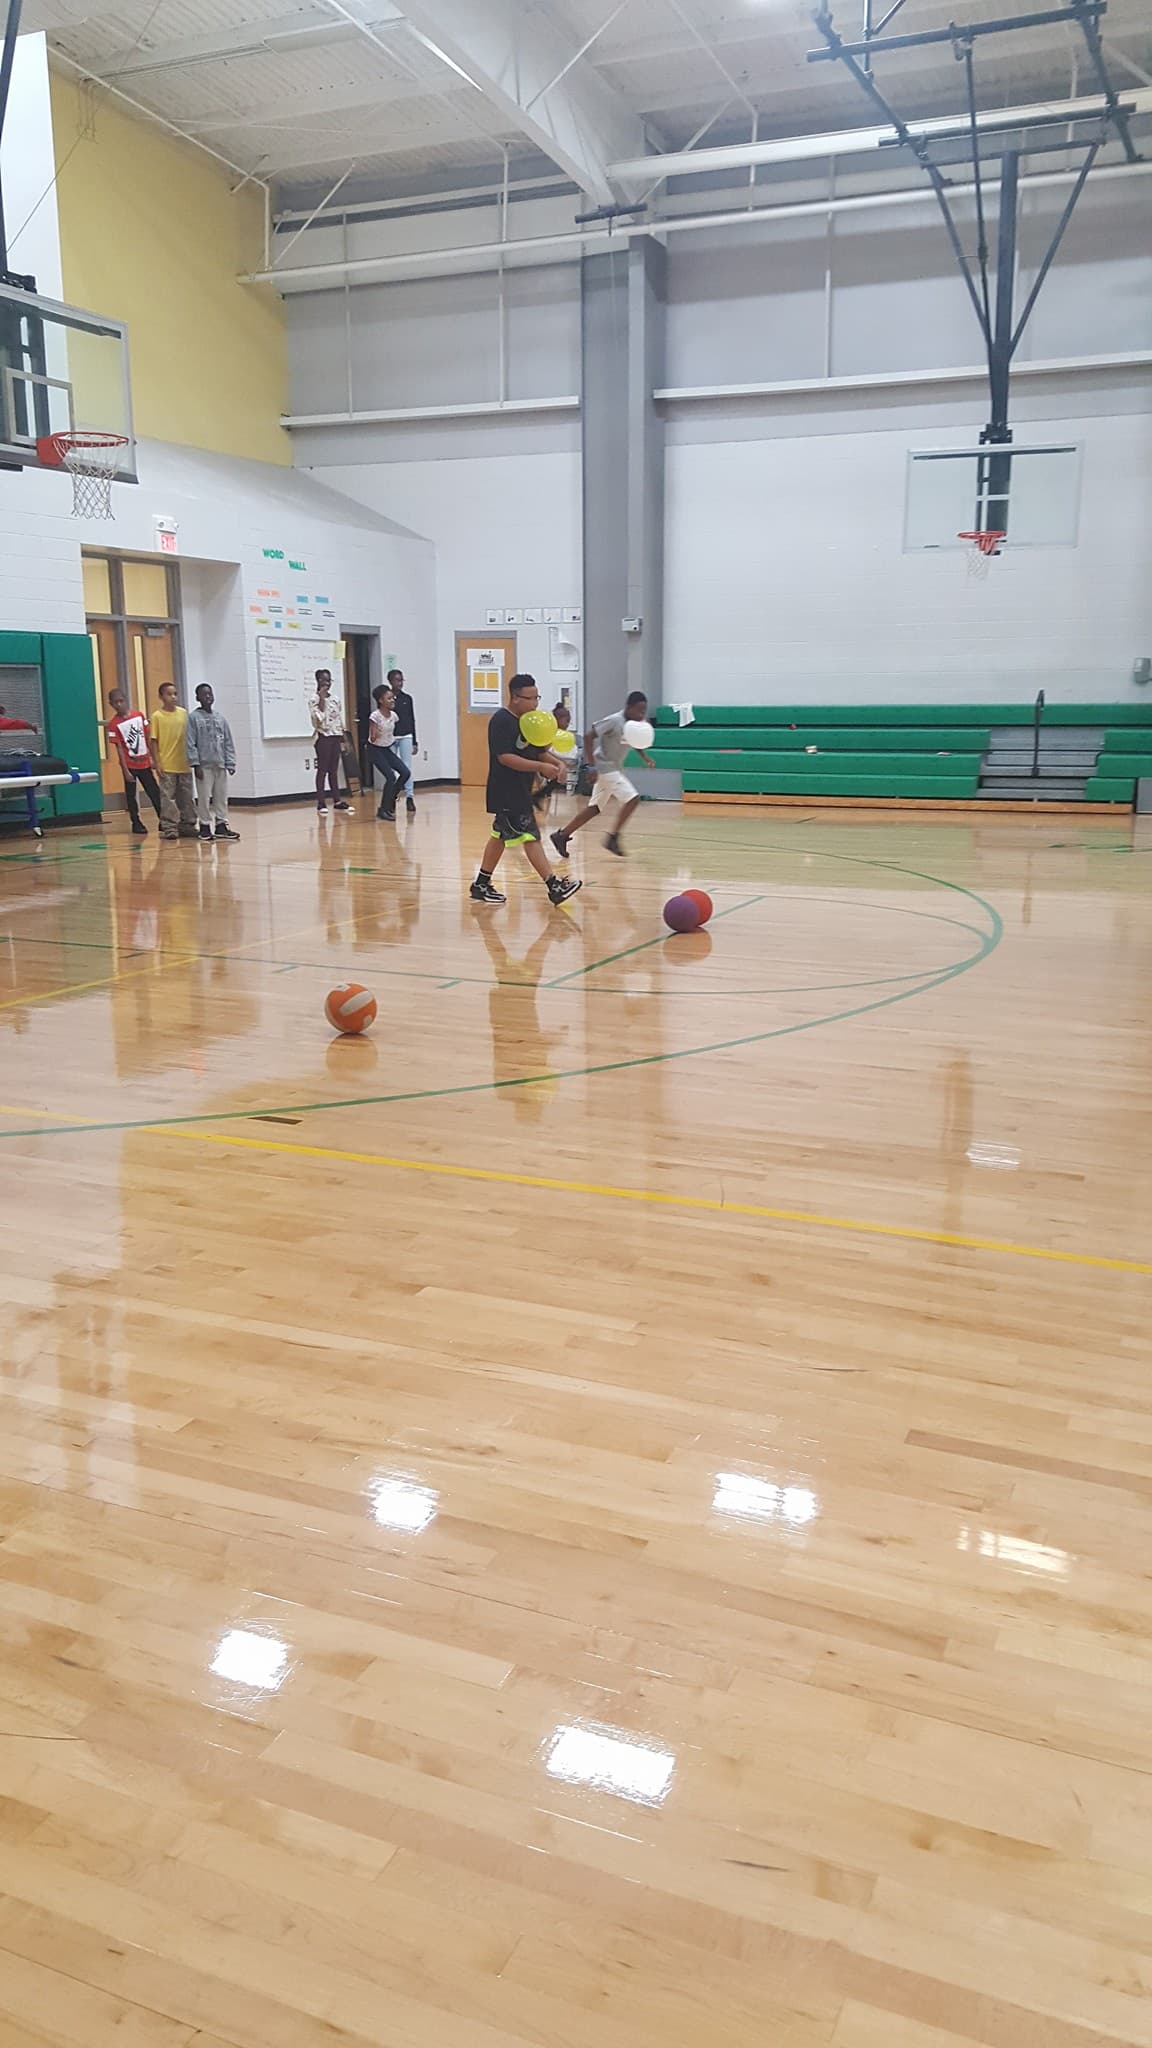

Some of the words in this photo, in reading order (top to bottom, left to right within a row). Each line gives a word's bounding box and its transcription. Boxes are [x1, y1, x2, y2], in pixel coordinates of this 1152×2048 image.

[160, 533, 176, 552] EXIT
[262, 548, 285, 560] WORD
[288, 560, 307, 571] WALL
[127, 724, 139, 746] NIKE
